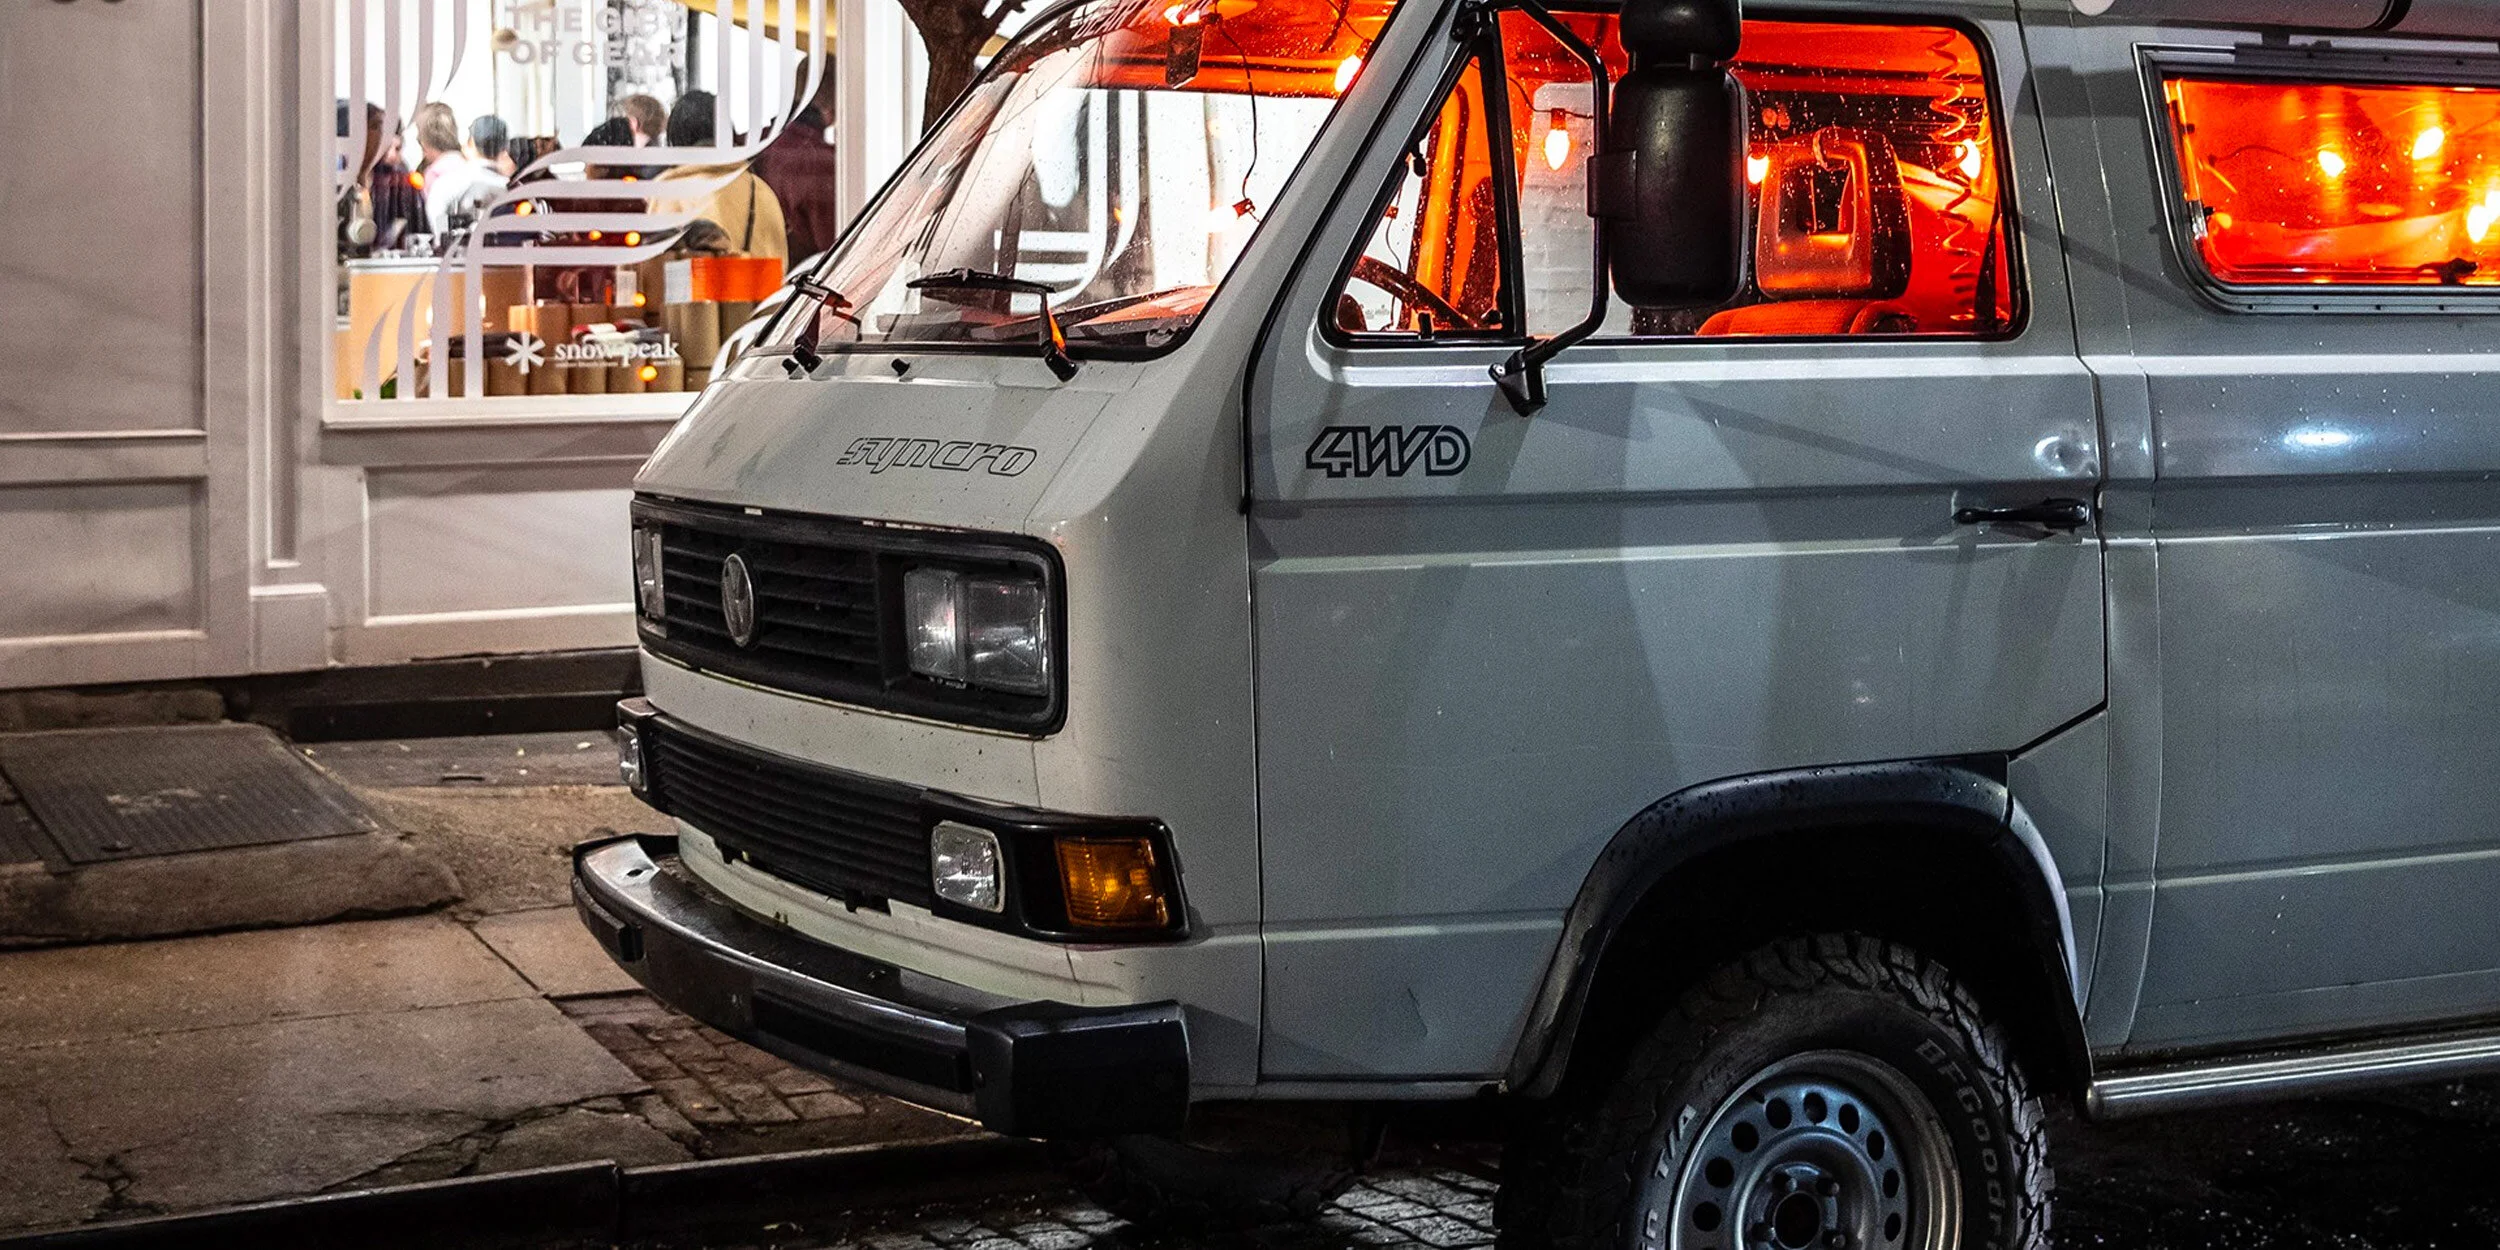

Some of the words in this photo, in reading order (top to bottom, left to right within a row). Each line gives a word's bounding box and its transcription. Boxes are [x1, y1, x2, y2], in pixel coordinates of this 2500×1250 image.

[505, 6, 582, 32] THE
[510, 40, 561, 64] OF
[555, 340, 617, 360] snow
[619, 333, 680, 367] peak
[836, 437, 1037, 477] syncro
[1305, 425, 1471, 478] 4WD
